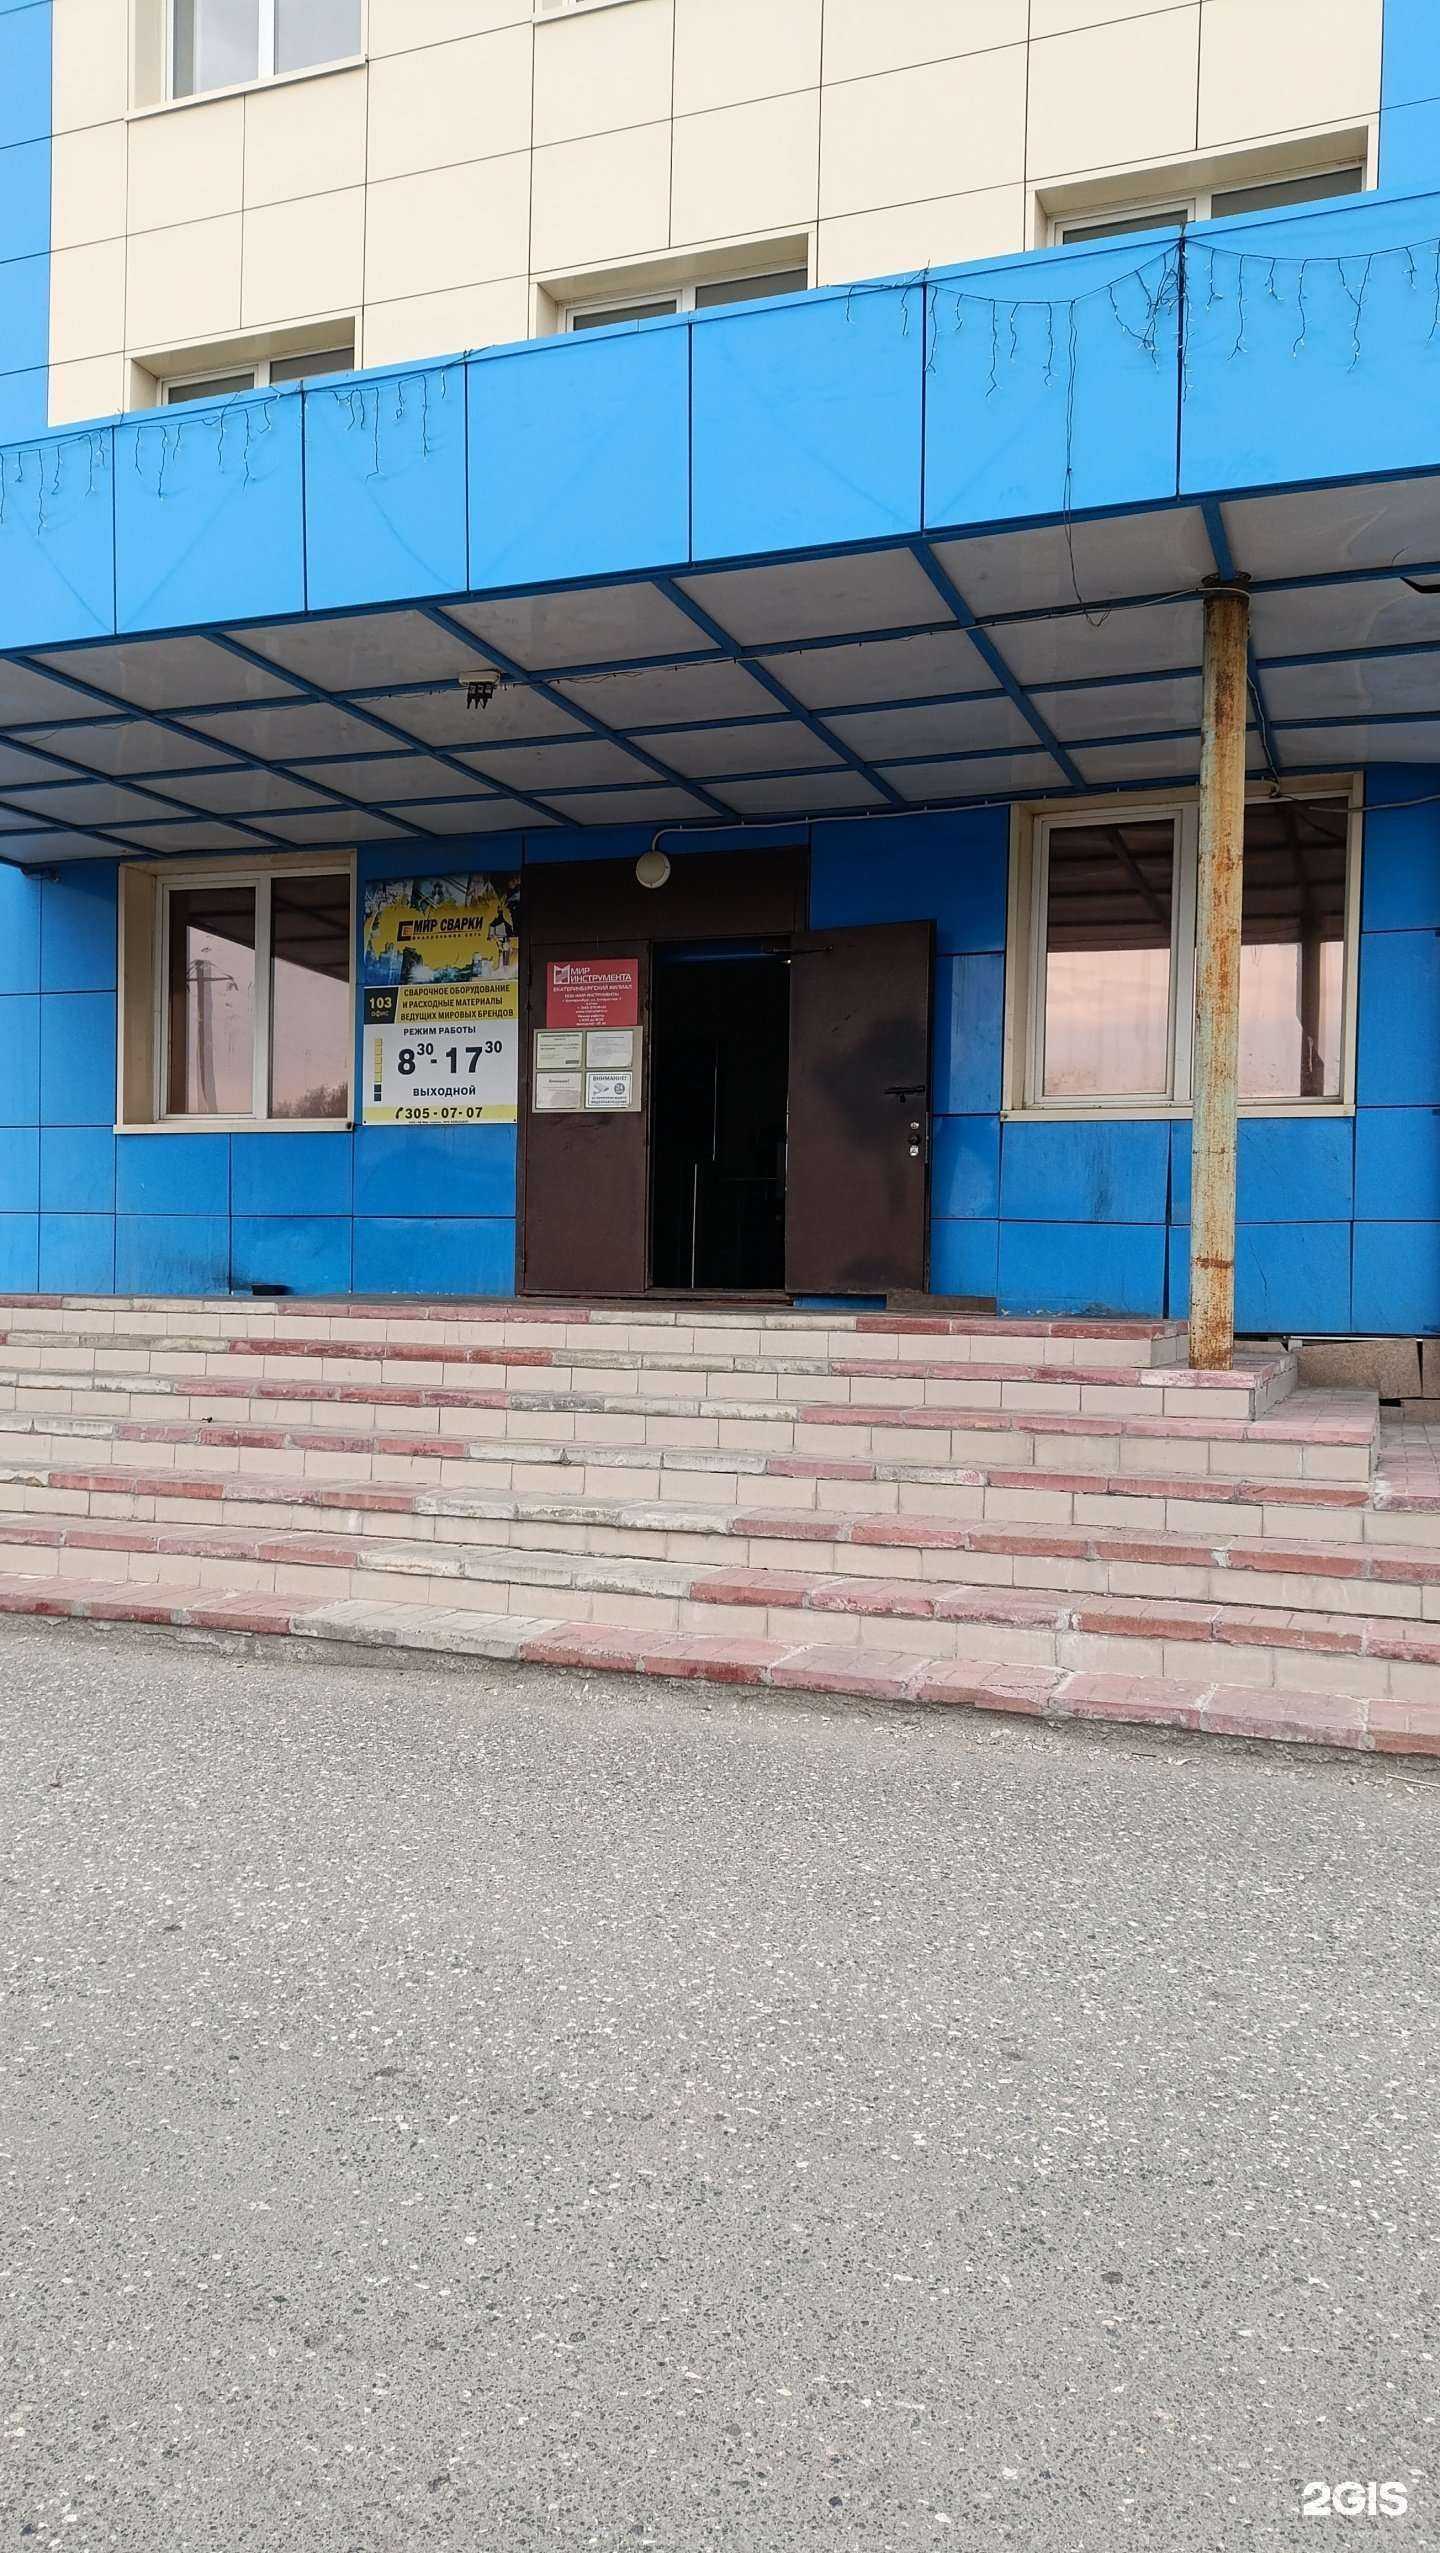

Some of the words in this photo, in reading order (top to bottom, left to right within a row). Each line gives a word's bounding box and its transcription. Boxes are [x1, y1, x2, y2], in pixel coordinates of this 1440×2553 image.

[414, 920, 438, 932] МИР
[440, 917, 483, 931] СВАРКИ
[570, 967, 590, 975] МИР
[571, 974, 632, 982] ИНСТРУМЕНТА
[404, 986, 449, 996] СВАРОЧНОЕ
[449, 984, 510, 995] ОБОРУДОВАНИЕ
[369, 997, 392, 1009] 103
[402, 1001, 408, 1009] И
[408, 999, 455, 1009] РАСХОДНЫЕ
[455, 997, 503, 1007] МАТЕРИАЛЫ
[400, 1011, 437, 1022] ВЕДУЩИХ
[438, 1010, 477, 1020] МИРОВЫХ
[478, 1008, 514, 1019] БРЕНДОВ
[403, 1027, 437, 1036] РЕЖИМ
[438, 1026, 476, 1035] РАБОТЫ
[413, 1085, 476, 1098] ВЫХОДНОЙ
